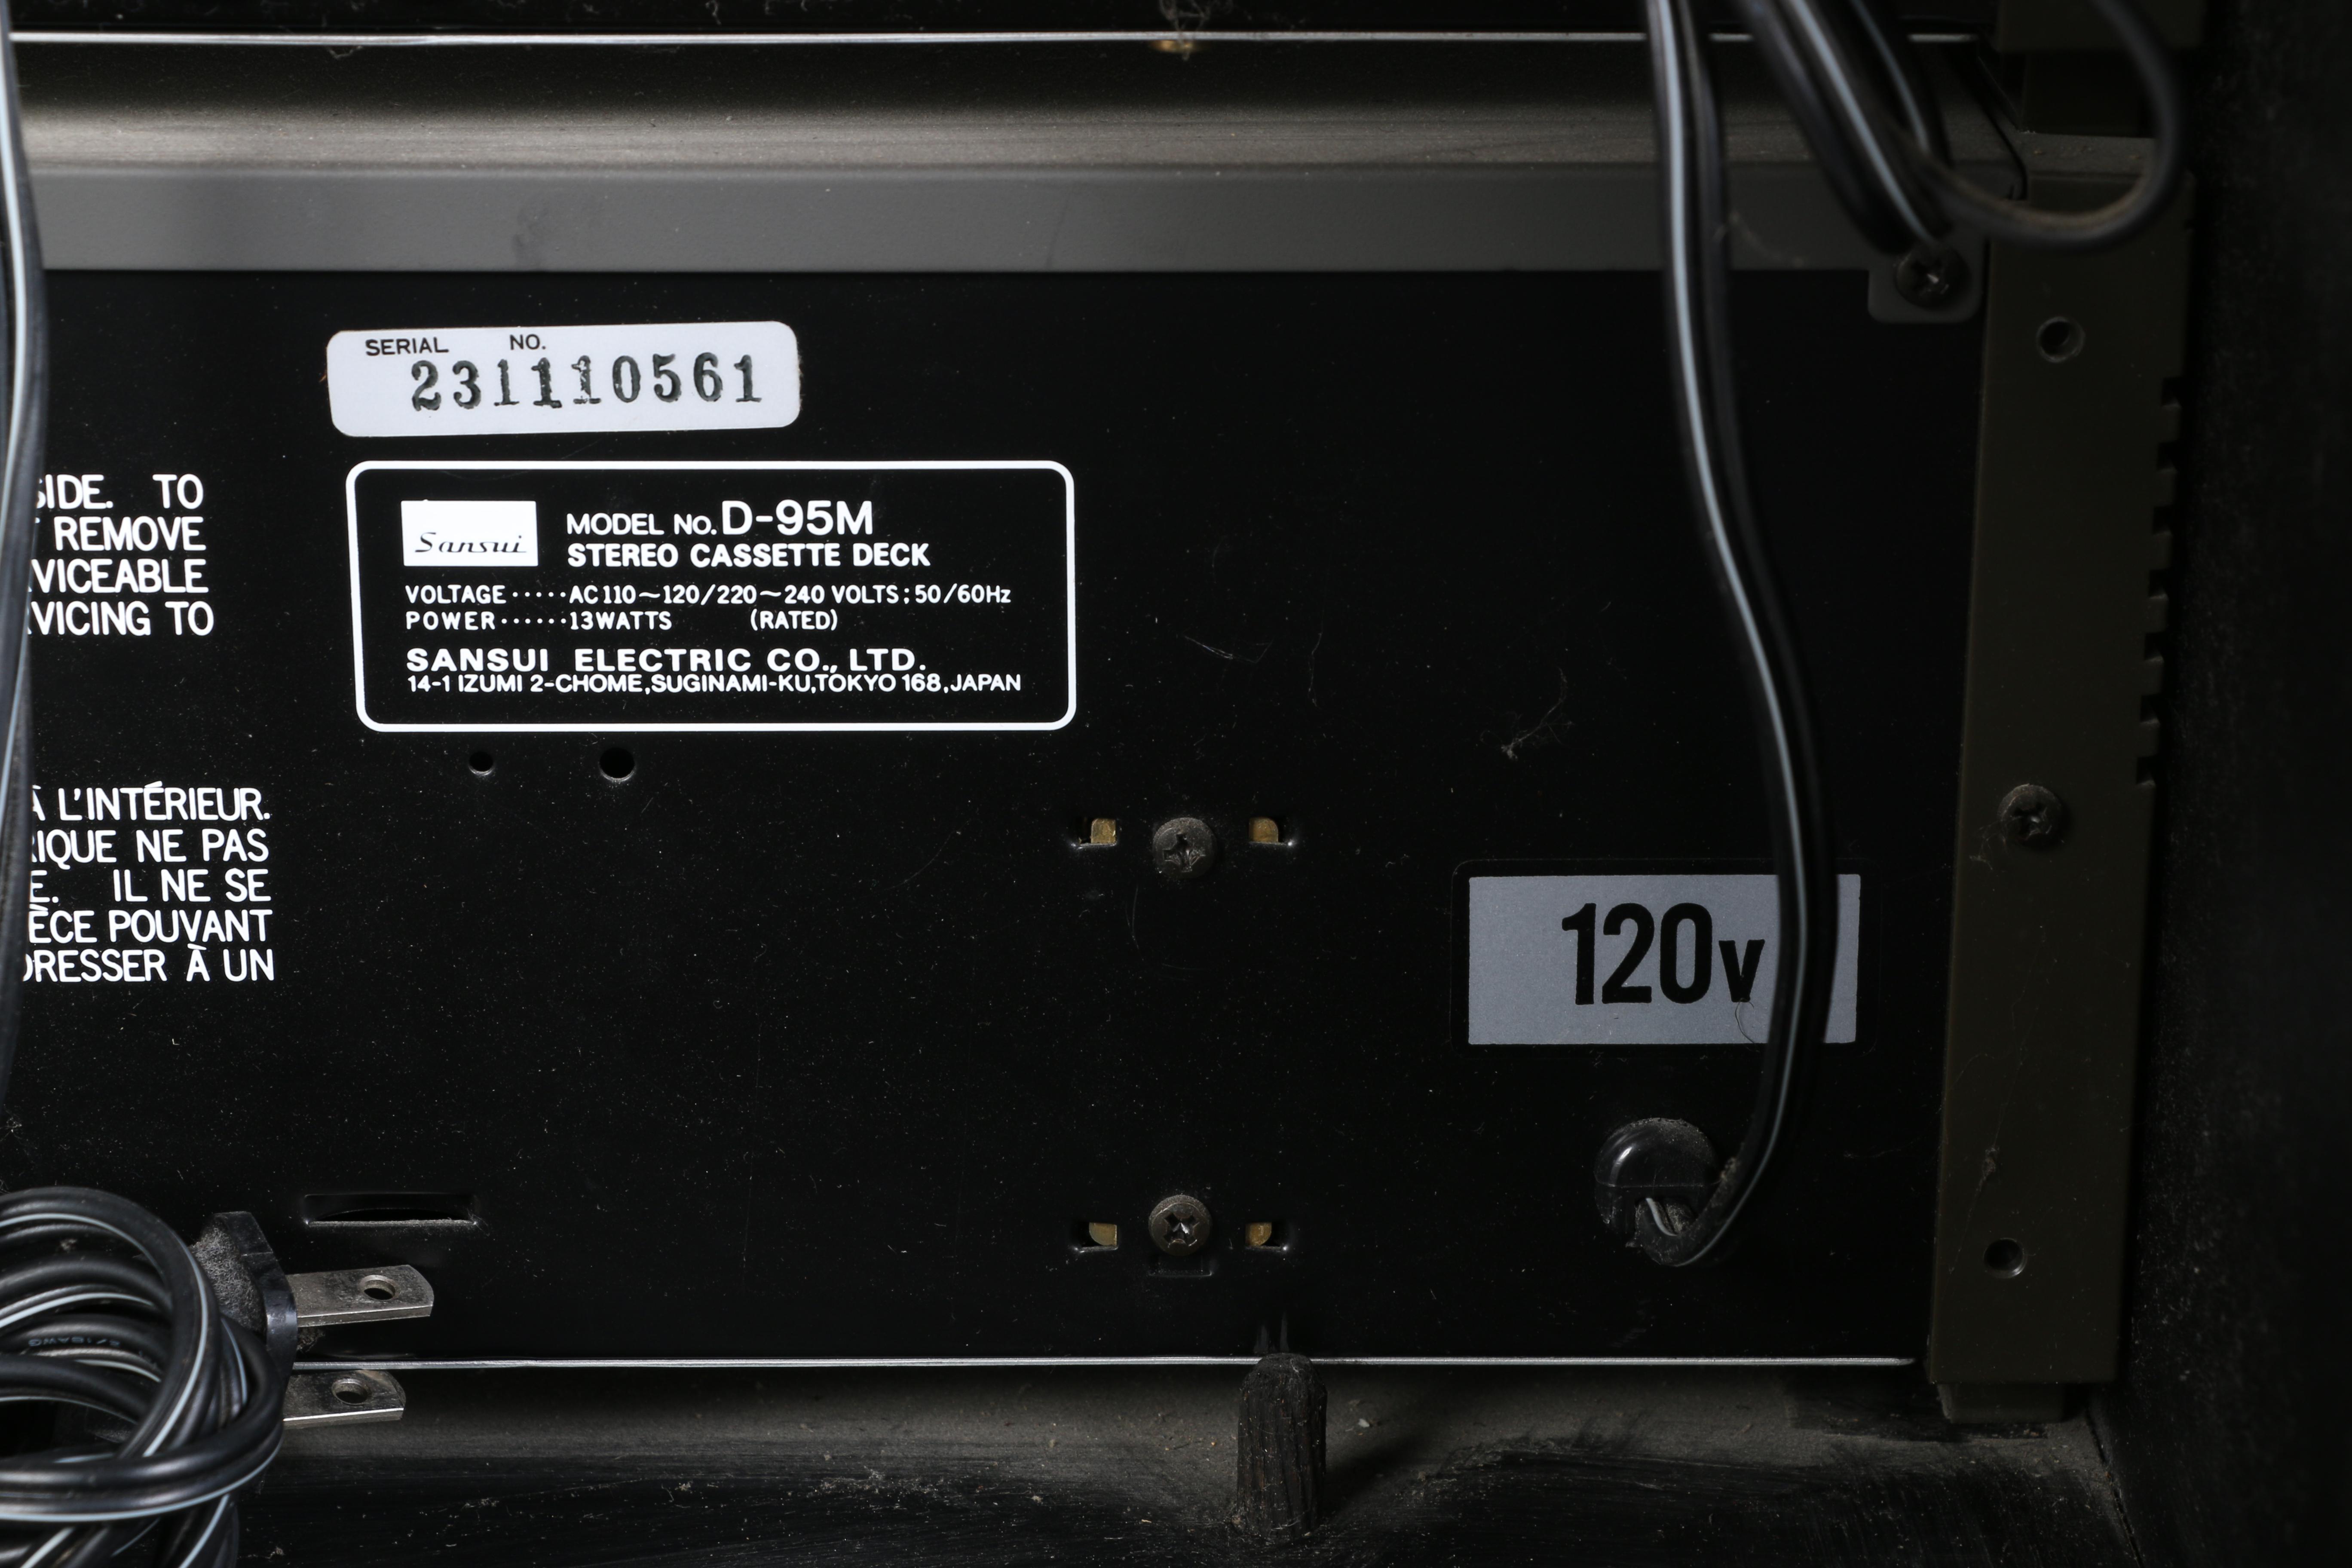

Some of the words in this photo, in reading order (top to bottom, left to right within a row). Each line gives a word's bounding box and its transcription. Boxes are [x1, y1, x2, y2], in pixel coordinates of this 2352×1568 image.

[366, 337, 449, 356] SERIAL
[510, 334, 546, 351] NO.
[411, 352, 763, 411] 231110561
[152, 474, 204, 509] TO
[53, 516, 207, 551] REMOVE
[567, 512, 665, 536] MODEL
[722, 499, 873, 536] D-95M
[414, 532, 527, 553] Sansui
[567, 543, 679, 568] STEREO
[690, 542, 841, 568] CASSETTE
[853, 542, 931, 567] DECK
[27, 558, 209, 594] VICEABLE
[26, 600, 151, 636] VICING
[165, 600, 214, 636] TO
[750, 608, 838, 631] (RATED)
[407, 648, 548, 672] SANSUI
[575, 648, 751, 672] ELECTRIC
[767, 648, 838, 674] CO.,
[849, 648, 926, 671] LTD.
[407, 675, 450, 692] 14-1
[458, 674, 523, 692] IZUMI
[58, 781, 270, 821] L'INTÉRIEUR.
[31, 829, 117, 870] IQUE
[136, 829, 187, 863] NE
[202, 828, 269, 862] PAS
[113, 869, 148, 902] IL
[161, 869, 211, 902] NE
[224, 867, 271, 902] SE
[108, 909, 273, 943] POUVANT
[186, 943, 210, 982] À
[223, 949, 274, 982] UN
